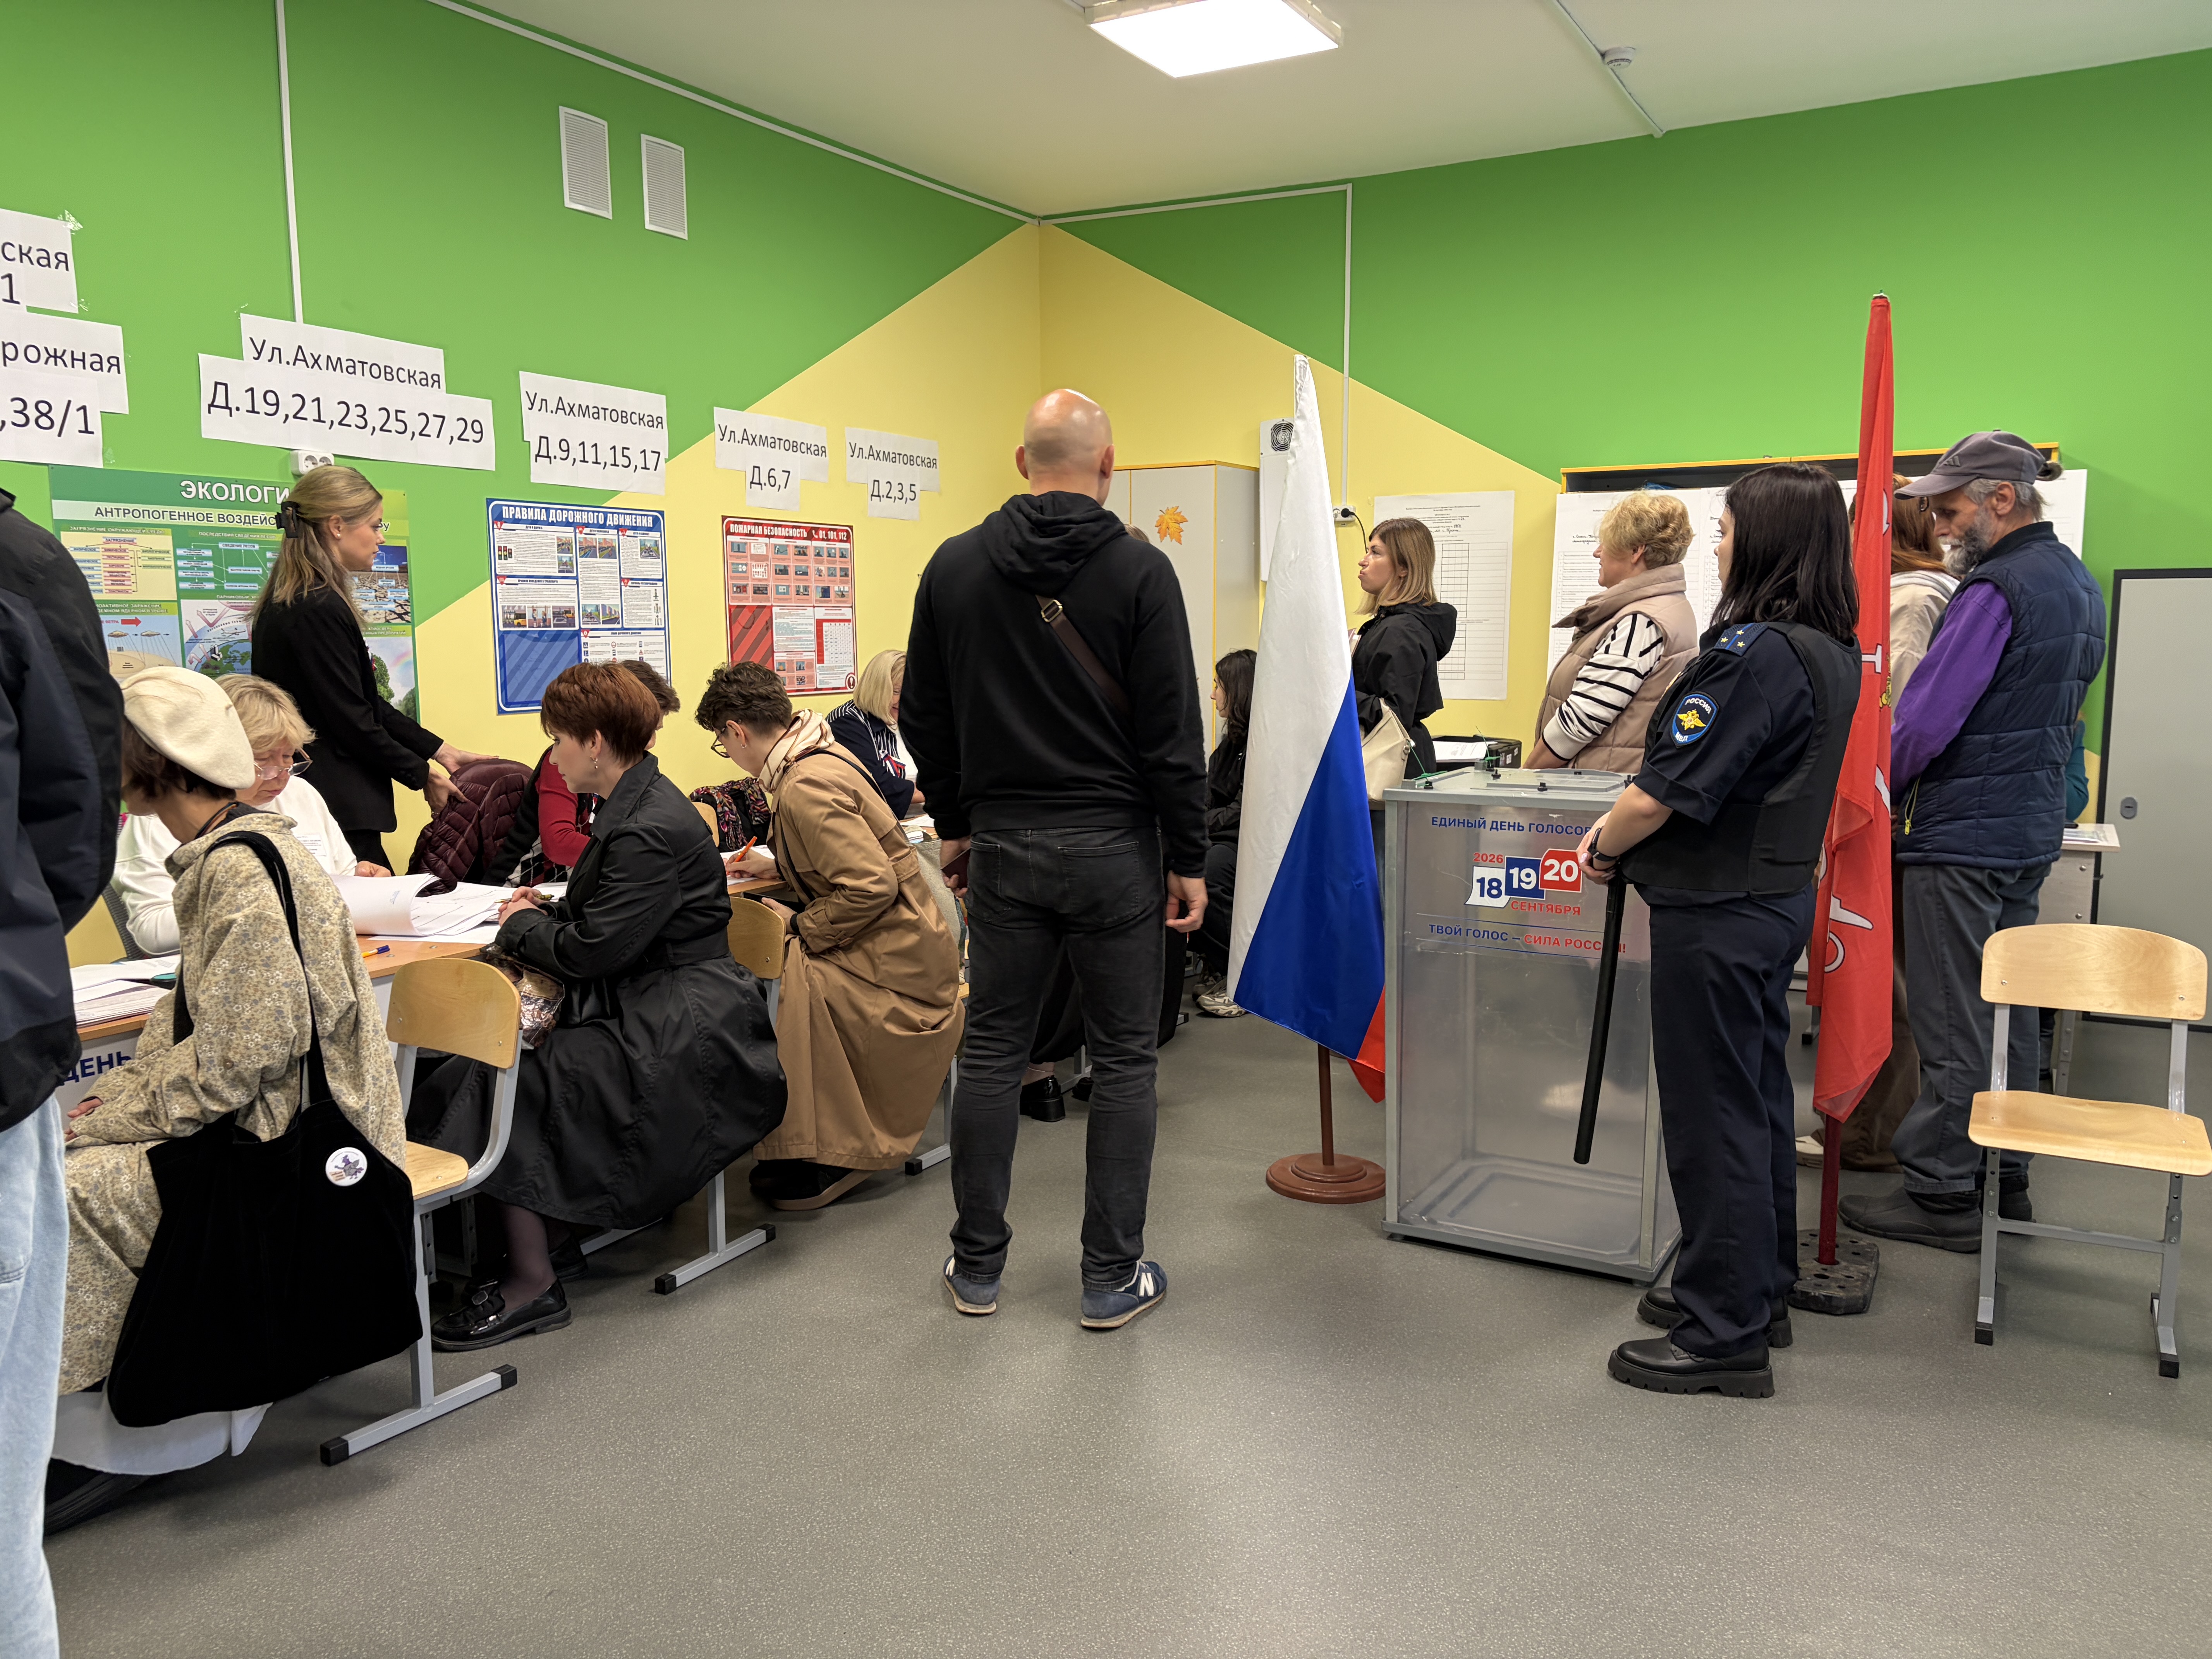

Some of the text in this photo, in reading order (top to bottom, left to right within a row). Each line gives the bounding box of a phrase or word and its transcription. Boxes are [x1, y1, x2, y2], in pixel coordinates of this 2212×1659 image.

[2, 242, 69, 271] ская
[2, 341, 121, 374] рожная
[249, 337, 441, 390] Ул.Ахматовская
[208, 381, 484, 445] Д.19,21,23,25,27,29
[526, 391, 664, 429] Ул.Ахматовская
[535, 436, 661, 473] Д.9,11,15,17
[718, 424, 826, 458] Ул.Ахматовская
[849, 442, 937, 469] Ул.Ахматовская
[750, 465, 791, 492] Д.6,7
[871, 479, 916, 501] Д.2,3,5
[94, 507, 213, 523] АНТРОПОГЕННОЕ
[502, 506, 653, 527] ПРАВИЛА ДОРОЖНОГО ДВИЖЕНИЯ
[730, 524, 763, 534] ПОЖАРНАЯ
[764, 526, 807, 538] БЕЗОПАСНОСТЬ
[839, 532, 847, 540] 112
[1685, 698, 1712, 714] РОССИЯ
[1675, 732, 1688, 742] МВД
[1432, 816, 1487, 830] ЕДИНЫЙ
[1489, 820, 1525, 832] ДЕНЬ
[1473, 852, 1503, 864] 2026
[1476, 859, 1578, 899] 18 19 20
[1511, 900, 1580, 916] СЕНТЯБРЯ
[1429, 924, 1462, 937] ТВОЙ
[1466, 929, 1508, 941] ГОЛОС
[1524, 934, 1561, 947] СИЛА
[1565, 938, 1626, 953] РОСС!
[1139, 1272, 1154, 1297] N
